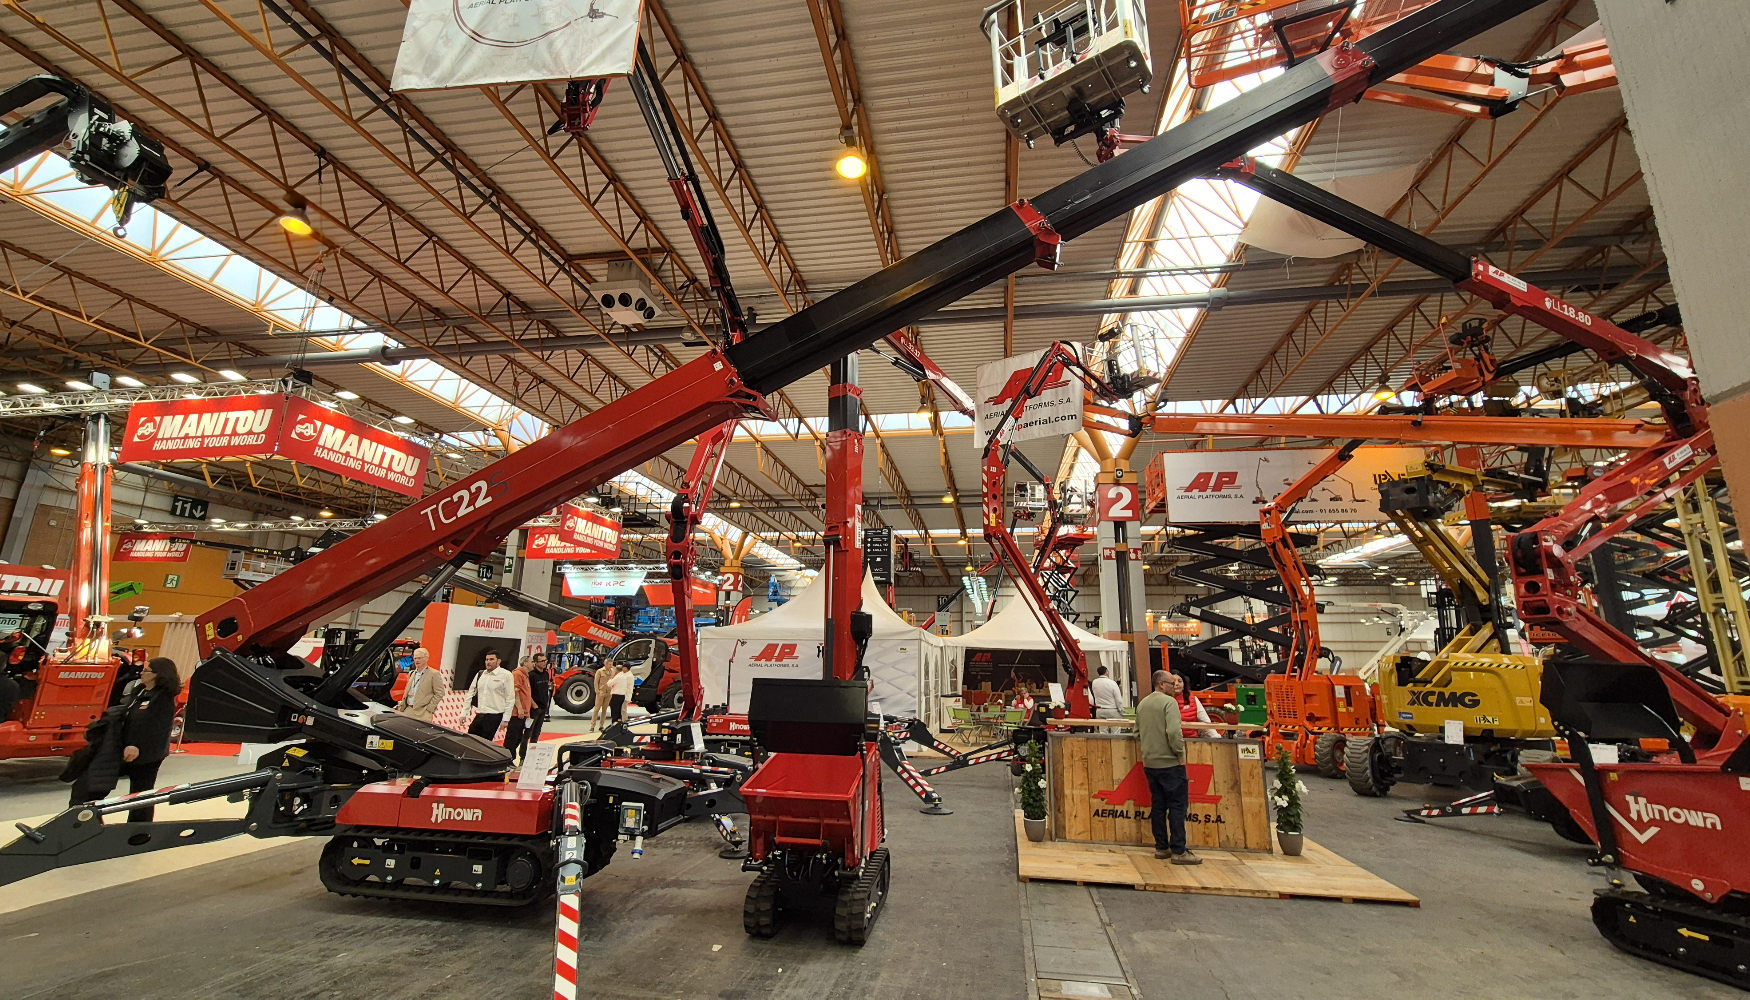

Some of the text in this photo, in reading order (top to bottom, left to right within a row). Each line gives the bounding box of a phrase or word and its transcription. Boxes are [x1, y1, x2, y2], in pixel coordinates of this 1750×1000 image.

[1202, 5, 1238, 26] JLG
[157, 408, 274, 439] MANITOU
[152, 433, 266, 451] HANDLING YOUR WORLD
[317, 424, 420, 477] MANITOU
[313, 446, 415, 488] HANDLING YOUR WORLD
[1176, 472, 1242, 492] AP
[174, 500, 191, 517] 11
[420, 470, 509, 531] TC22S
[1107, 485, 1133, 517] 2
[575, 518, 618, 545] MANITOU
[479, 567, 487, 577] 11
[722, 573, 734, 590] 2
[474, 617, 505, 630] MANITOU
[749, 643, 799, 662] AP
[58, 671, 105, 679] MANITOU
[1407, 690, 1481, 709] XCMG
[1474, 714, 1499, 725] IPAF
[1092, 808, 1132, 819] AERIAL
[1204, 814, 1226, 824] S.A.
